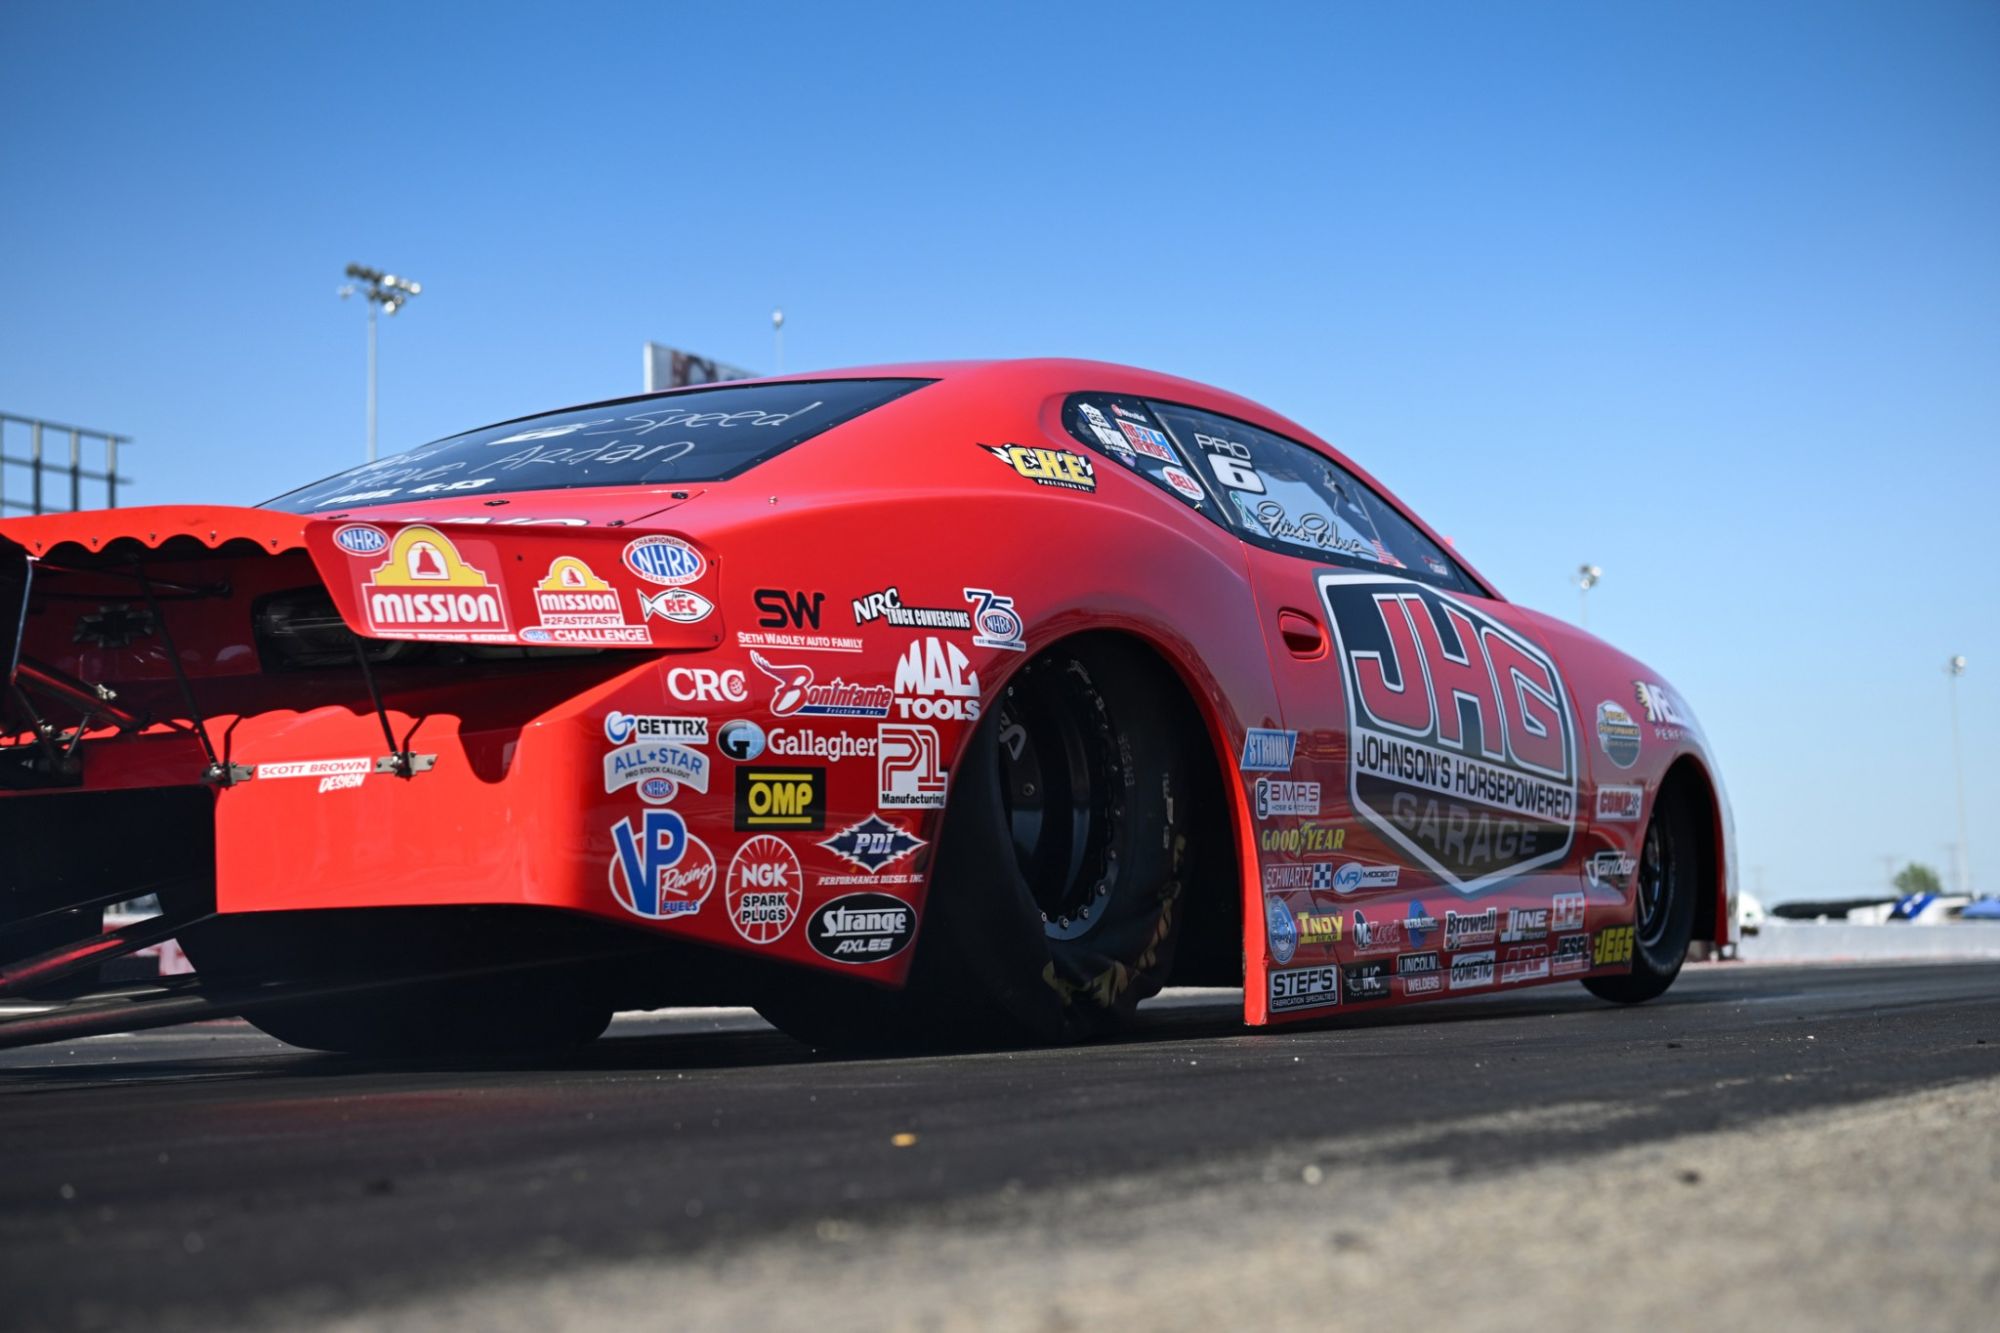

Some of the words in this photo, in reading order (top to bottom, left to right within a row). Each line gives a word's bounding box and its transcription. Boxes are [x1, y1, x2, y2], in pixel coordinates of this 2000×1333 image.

[1194, 433, 1251, 460] PRO
[1207, 453, 1266, 496] 6
[339, 529, 383, 549] NHRA
[635, 544, 696, 576] NHRA
[371, 594, 500, 623] MISSION
[540, 594, 616, 611] MISSION
[664, 599, 698, 613] RFC
[754, 588, 826, 630] SW
[852, 587, 901, 624] NRC
[543, 616, 621, 626] #2FAST2TASTY
[885, 608, 915, 624] TRUCK
[915, 610, 971, 629] CONVERSIONS
[986, 615, 1012, 633] NHRA
[554, 629, 646, 642] CHALLENGE
[807, 637, 830, 647] AUTO
[831, 637, 863, 649] FAMILY
[895, 637, 980, 697] MAC
[667, 668, 748, 702] CRC
[1350, 593, 1567, 780] JHG
[895, 698, 980, 721] TOOLS
[638, 719, 706, 736] GETTRX
[768, 728, 878, 762] Gallagher
[261, 765, 304, 776] SCOTT
[309, 761, 367, 773] BROWN
[615, 750, 646, 774] ALL
[659, 748, 703, 775] STAR
[640, 767, 660, 775] STOCK
[319, 775, 363, 793] DESIGN
[1356, 735, 1451, 791] JOHNSON'S
[1455, 760, 1574, 822] HORSEPOWERED
[748, 782, 813, 815] OMP
[882, 794, 945, 807] Manufacturing
[1392, 792, 1541, 866] GARAGE
[853, 833, 894, 854] PDI
[615, 813, 686, 915] VP
[661, 863, 712, 900] Racing
[742, 865, 787, 887] NGK
[662, 901, 699, 911] FUELS
[742, 895, 786, 907] SPARK
[742, 909, 786, 922] PLUGS
[821, 906, 906, 937] Strange
[1447, 911, 1495, 934] Browell
[834, 938, 893, 954] AXLES
[1594, 928, 1634, 965] JEGS
[1400, 956, 1436, 972] LINCOLN
[1273, 969, 1334, 996] STEF'S
[1408, 977, 1440, 992] WELDERS
